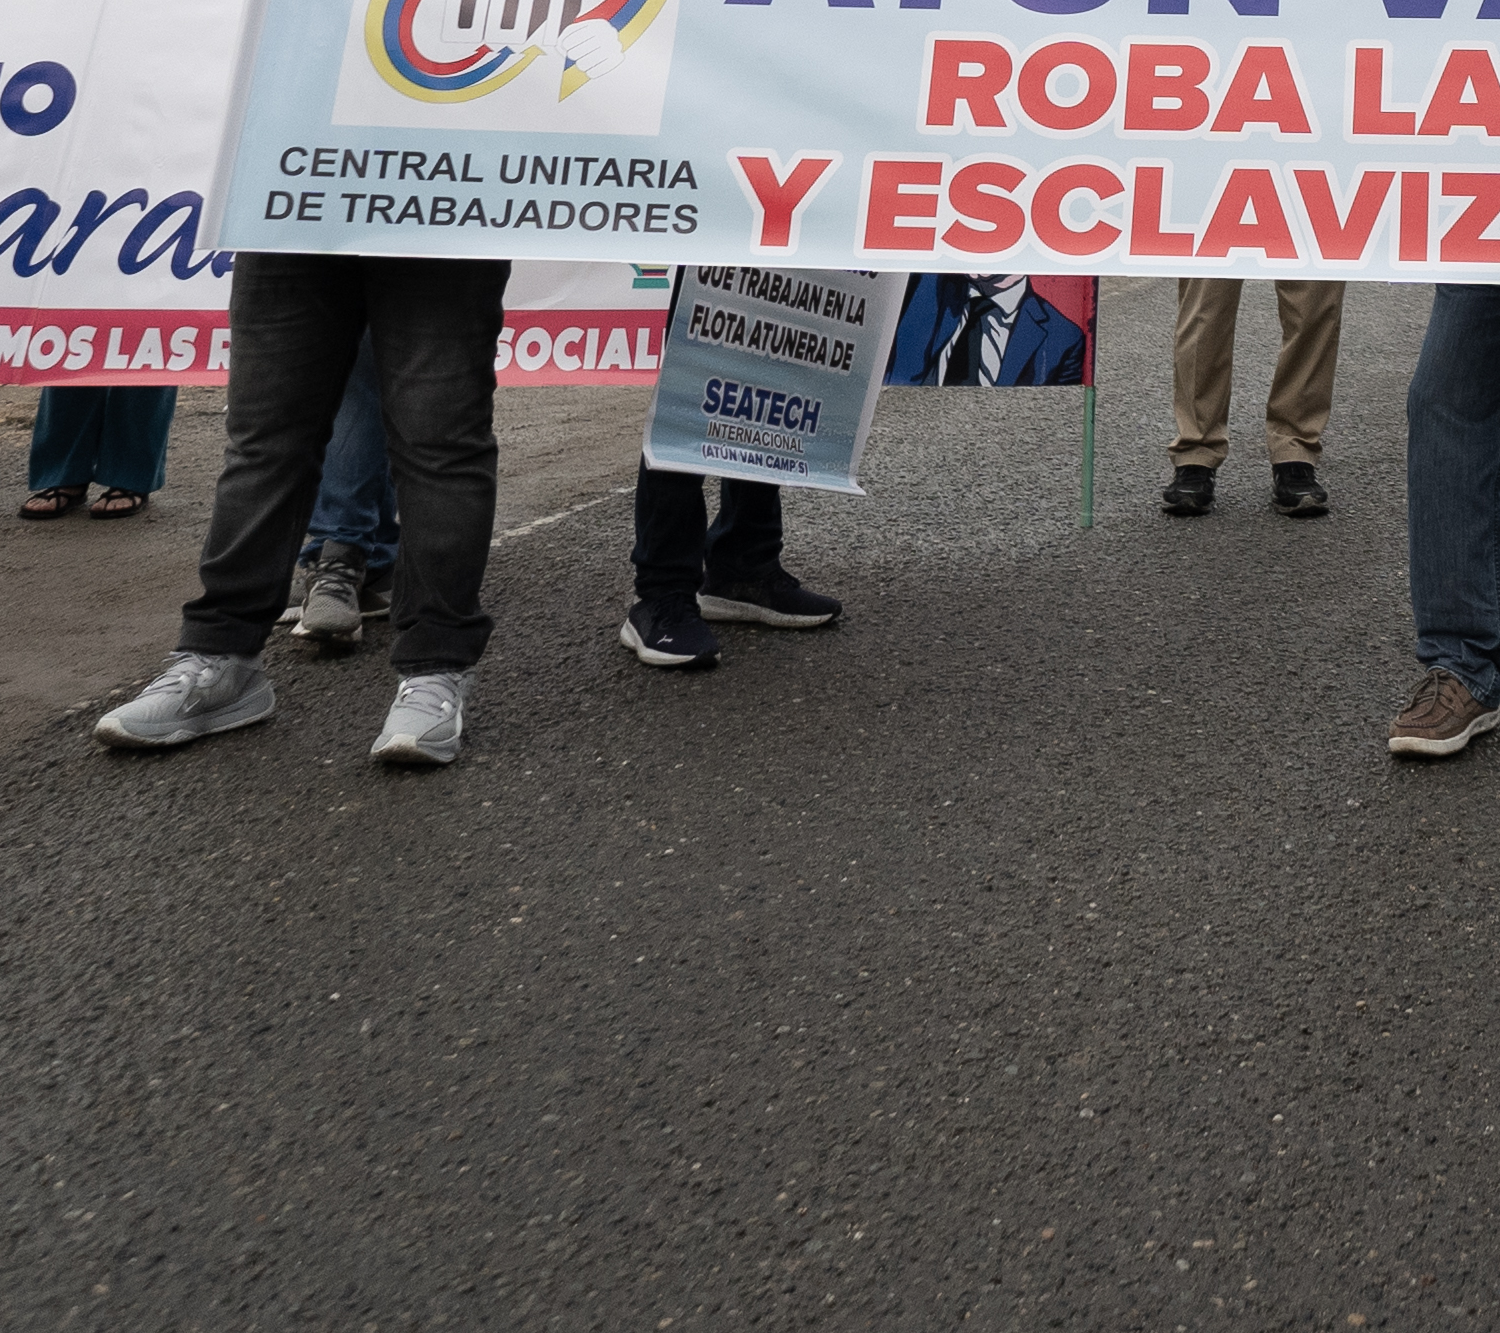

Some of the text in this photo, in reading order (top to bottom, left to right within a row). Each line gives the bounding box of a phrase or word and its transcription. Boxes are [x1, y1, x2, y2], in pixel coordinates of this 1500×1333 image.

[925, 39, 1309, 136] ROBA
[279, 146, 698, 190] CENTRAL UNITARIA
[264, 191, 699, 235] DE TRABAJADORES
[738, 156, 832, 247] Y
[698, 267, 865, 326] QUE TRABAJAN EN LA
[104, 327, 198, 372] LAS
[494, 326, 666, 372] SOCIAL
[689, 304, 855, 371] FLOTA ATUNERA DE
[702, 378, 822, 433] SEATECH
[707, 422, 804, 453] INTERNACIONAL
[740, 450, 763, 467] VAN
